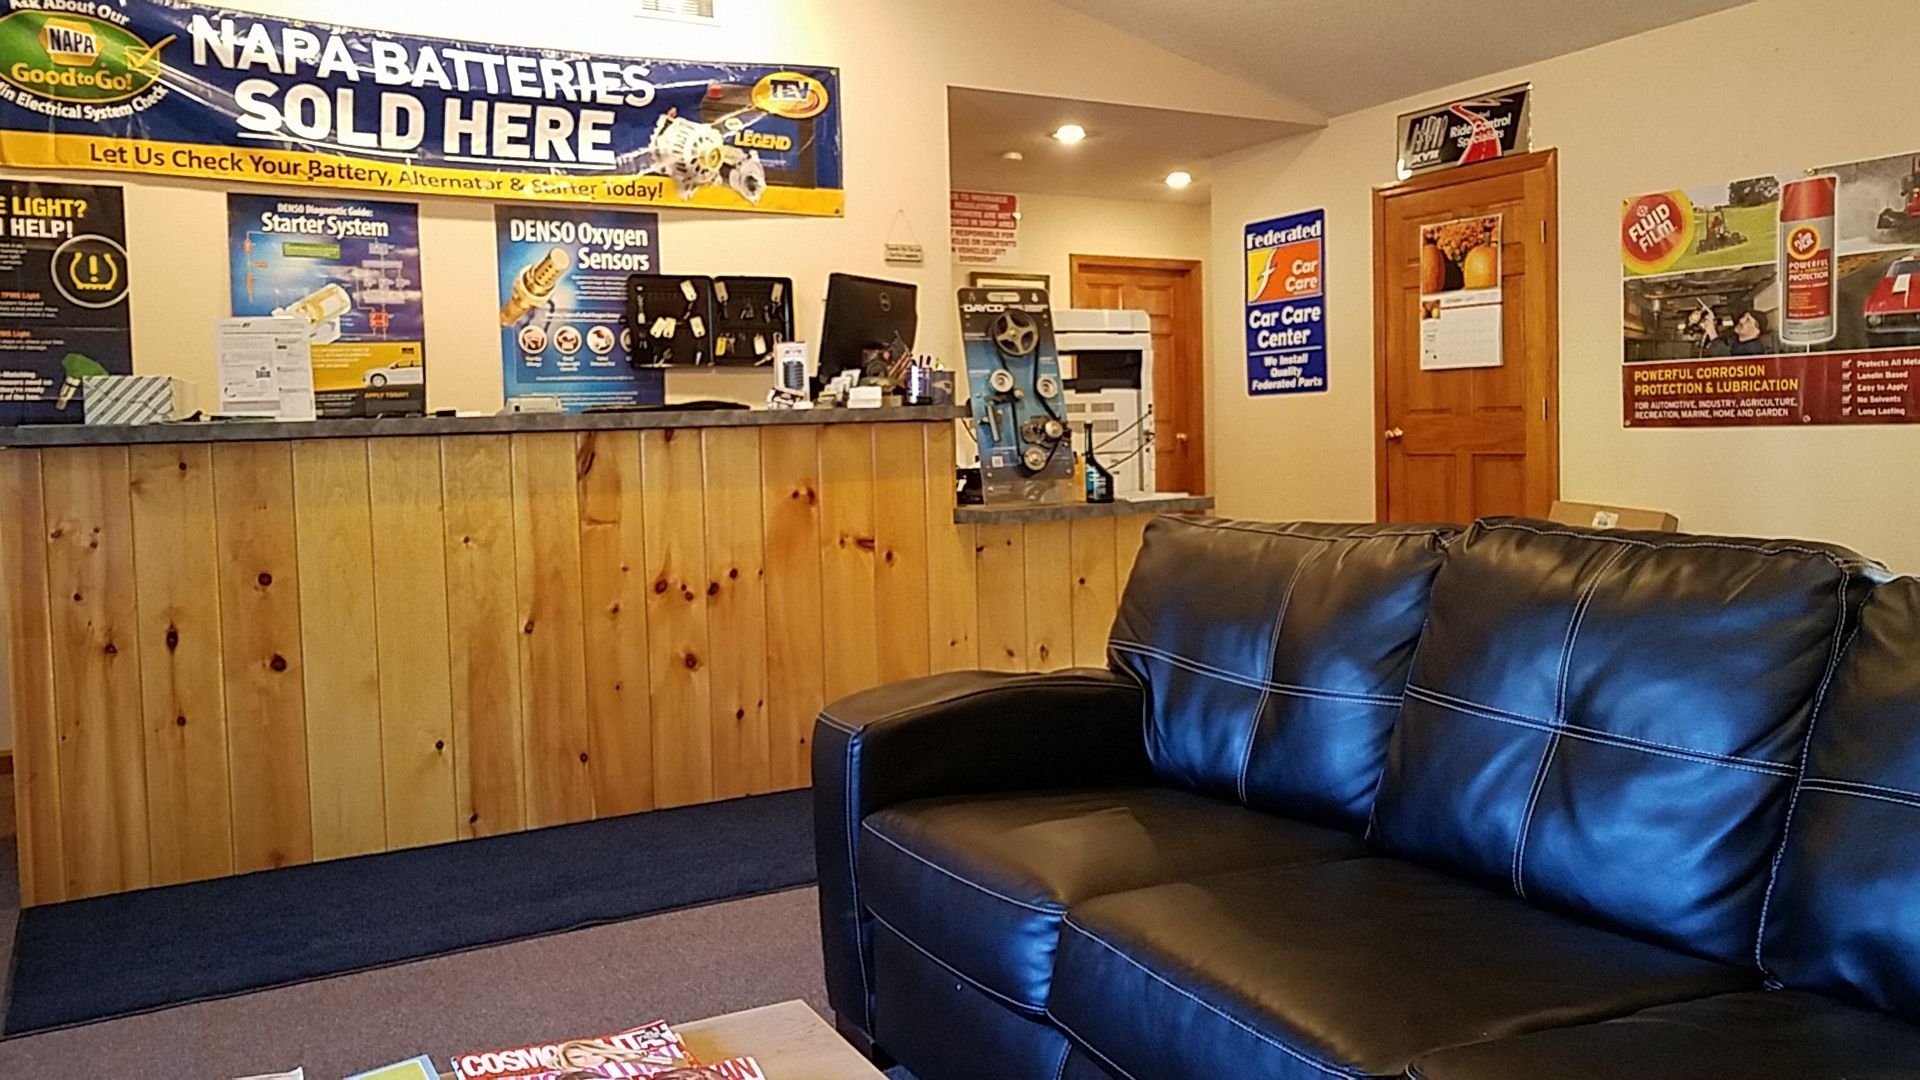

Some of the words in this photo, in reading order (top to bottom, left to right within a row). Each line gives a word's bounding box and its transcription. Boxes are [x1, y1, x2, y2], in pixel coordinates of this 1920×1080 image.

[43, 0, 95, 15] About
[97, 4, 130, 25] Our
[49, 28, 94, 54] NAPA
[192, 14, 360, 82] NAPA
[373, 37, 656, 107] BATTERIES
[11, 62, 77, 87] Good
[94, 69, 133, 91] Go!
[15, 91, 82, 119] Electrical
[83, 103, 134, 122] System
[131, 84, 169, 112] Check
[235, 79, 426, 151] SOLD
[444, 98, 615, 164] HERE
[1450, 123, 1472, 138] Ride
[1474, 112, 1512, 131] Control
[735, 129, 792, 151] LEGEND
[90, 143, 127, 163] Let
[134, 146, 165, 166] Us
[172, 150, 243, 172] Check
[250, 155, 300, 176] Your
[309, 160, 393, 186] Battery,
[399, 170, 503, 191] Alternator
[510, 178, 524, 191] &
[532, 179, 596, 196] Starter
[604, 181, 664, 200] Today!
[12, 196, 87, 218] LIGHT?
[277, 203, 304, 213] DENSO
[305, 204, 347, 216] Diagnostic
[10, 217, 73, 239] HELP!
[261, 212, 325, 233] Starter
[326, 216, 389, 240] System
[1628, 203, 1670, 243] FLUID
[510, 219, 576, 243] DENSO
[578, 222, 648, 251] Oxygen
[1246, 219, 1321, 249] Federated
[1639, 219, 1676, 253] FILM
[578, 247, 650, 271] Sensors
[1291, 259, 1318, 275] Car
[1788, 259, 1829, 269] POWERFUL
[1284, 276, 1318, 292] Care
[1788, 271, 1829, 281] PROTECTION
[963, 303, 1005, 313] DAYCO
[1249, 309, 1279, 329] Car
[1281, 306, 1321, 325] Care
[1257, 328, 1311, 349] Center
[1264, 355, 1278, 367] We
[1279, 352, 1309, 366] Install
[1856, 360, 1889, 368] Protects
[1891, 358, 1902, 367] All
[1270, 366, 1303, 378] Quality
[1634, 368, 1694, 382] POWERFUL
[1696, 364, 1765, 380] CORROSION
[1856, 372, 1884, 380] Lanolin
[1885, 371, 1909, 379] Based
[1251, 378, 1297, 391] Federated
[1297, 376, 1323, 387] Parts
[1634, 383, 1703, 396] PROTECTION
[1705, 382, 1714, 394] &
[1716, 378, 1799, 394] LUBRICATION
[1856, 384, 1875, 393] Easy
[1886, 383, 1909, 392] Apply
[1634, 401, 1649, 410] FOR
[1650, 400, 1697, 410] AUTOMOTIVE,
[1699, 399, 1738, 409] INDUSTRY,
[1740, 397, 1798, 408] AGRICULTURE,
[1857, 396, 1868, 404] No
[1869, 395, 1902, 404] Solvents
[1634, 410, 1680, 419] RECREATION,
[1681, 409, 1712, 419] MARINE,
[1713, 409, 1736, 418] HOME
[1737, 409, 1753, 417] AND
[1755, 408, 1789, 417] GARDEN
[1857, 407, 1876, 416] Long
[1877, 407, 1906, 416] Lasting
